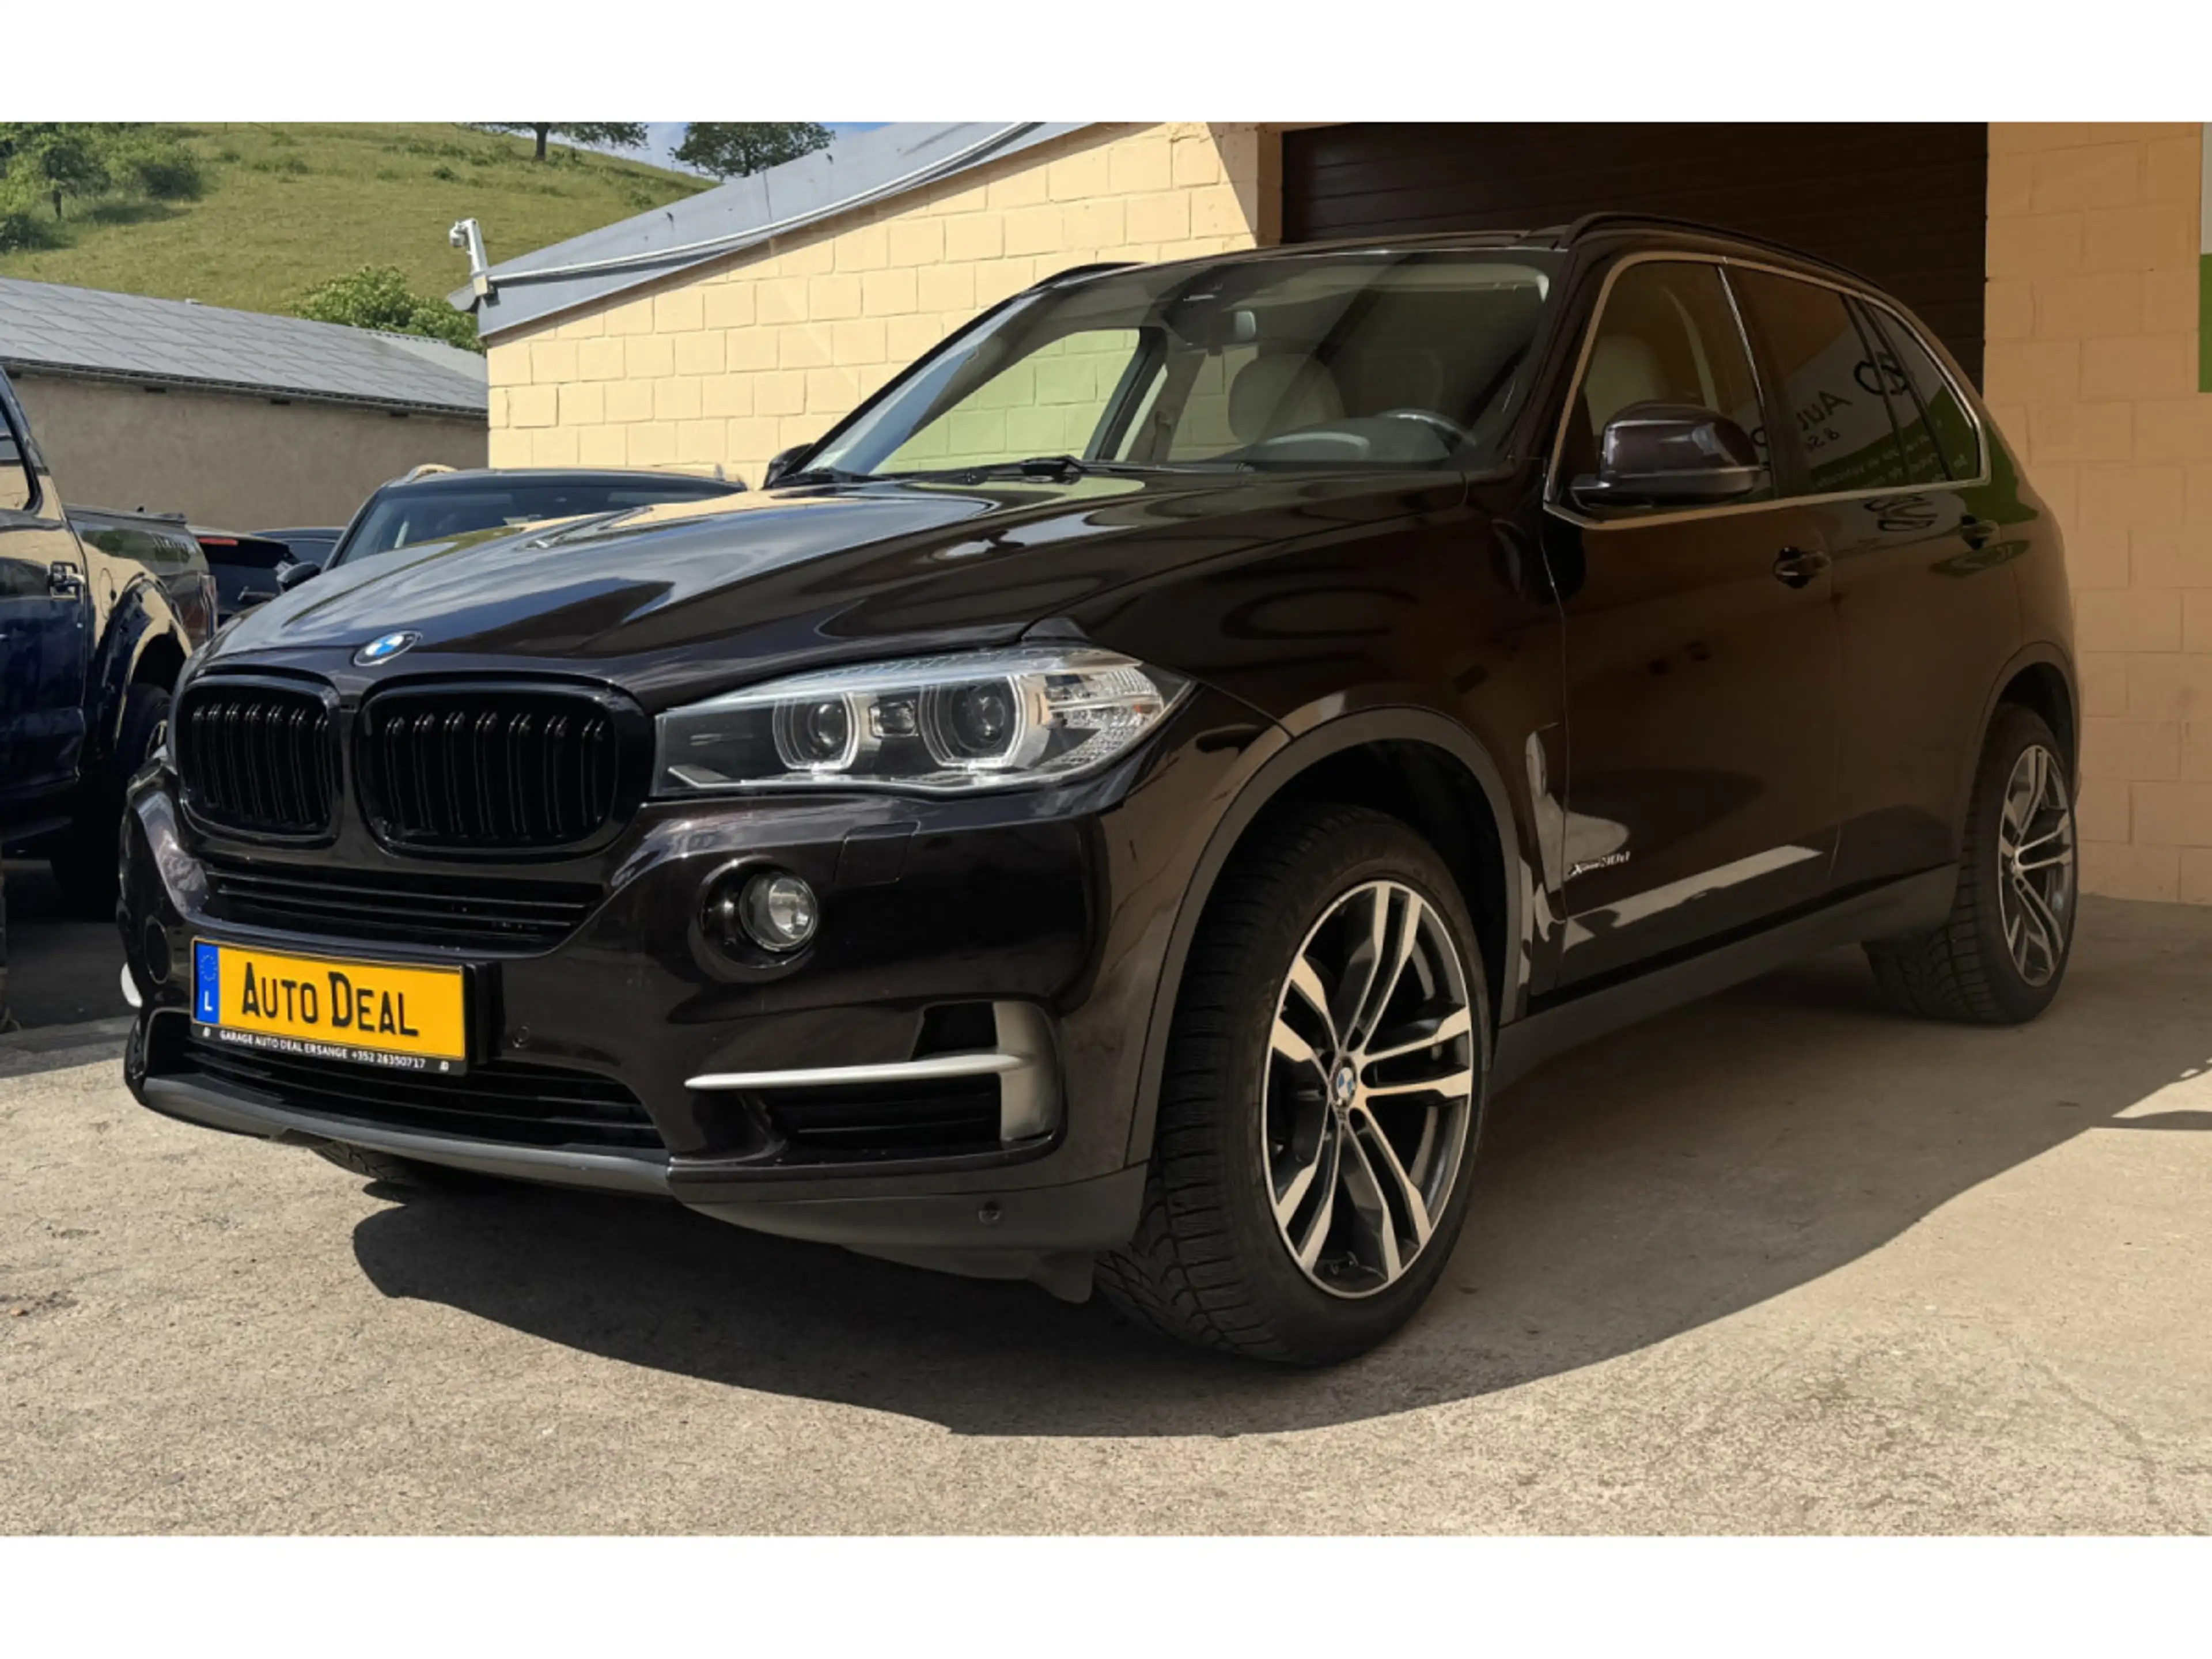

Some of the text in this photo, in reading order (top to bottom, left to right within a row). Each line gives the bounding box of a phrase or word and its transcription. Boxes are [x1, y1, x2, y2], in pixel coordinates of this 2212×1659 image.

[204, 990, 213, 1012] L
[242, 962, 419, 1036] AUTO DEAL
[219, 1029, 253, 1044] GARAGE
[255, 1036, 279, 1048] AUTO
[280, 1039, 302, 1052] DEAL
[304, 1043, 347, 1059] ERSANGE
